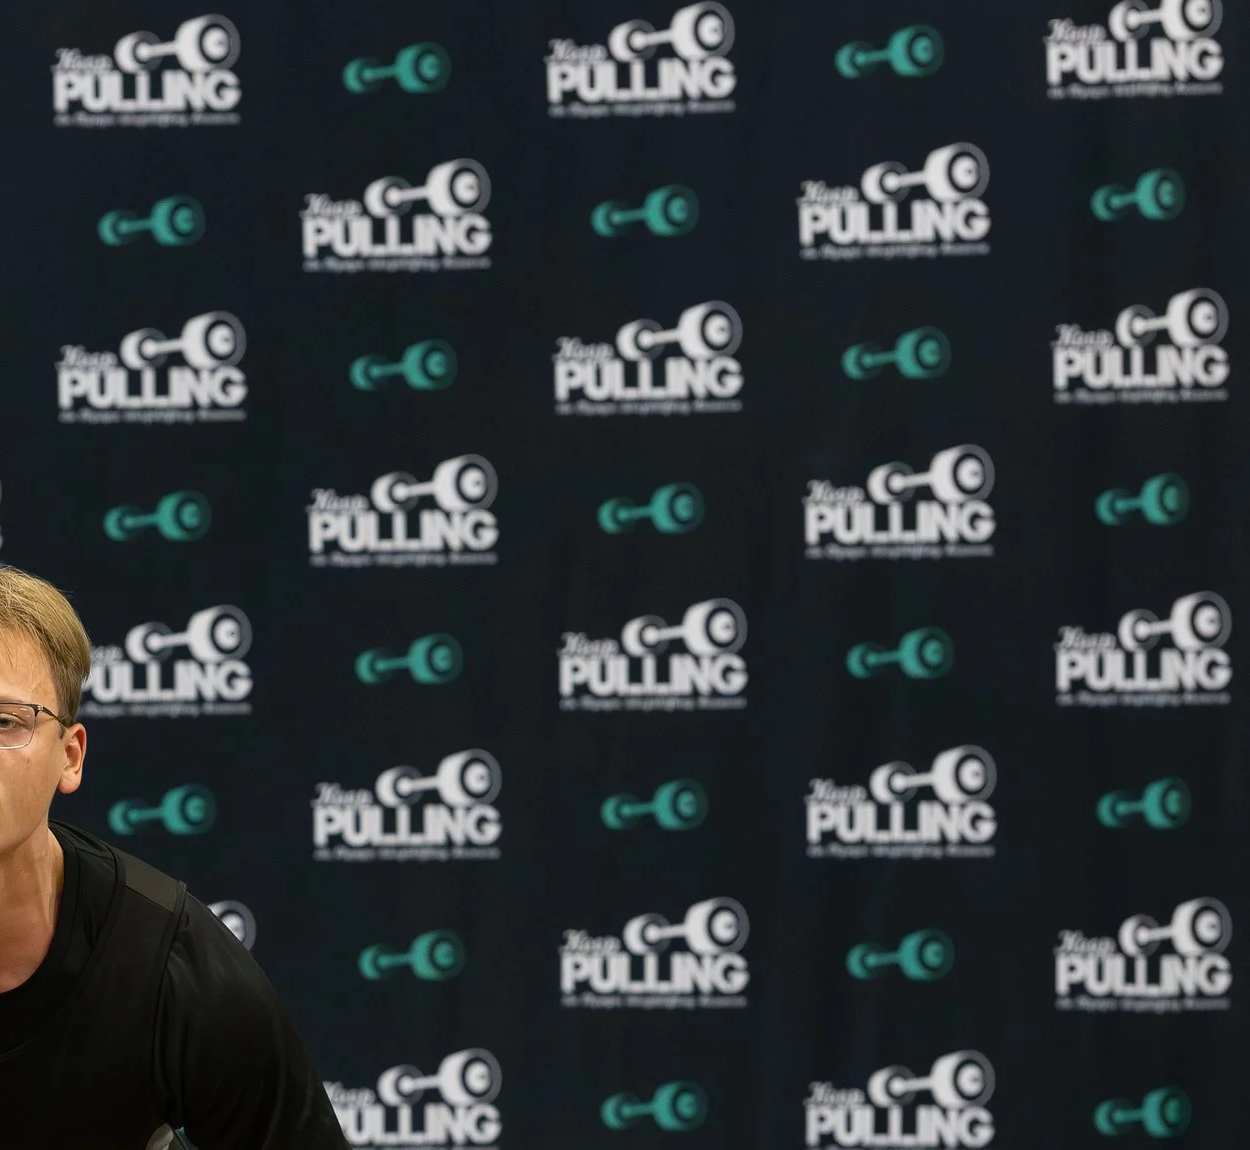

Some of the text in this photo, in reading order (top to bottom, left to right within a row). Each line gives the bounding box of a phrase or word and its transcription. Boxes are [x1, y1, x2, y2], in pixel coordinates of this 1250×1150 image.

[547, 58, 736, 101] PULLING
[1048, 38, 1222, 82] PULLING
[52, 69, 241, 112] PULLING
[302, 214, 491, 257] PULLING
[798, 199, 991, 243] PULLING
[58, 366, 247, 408] PULLING
[554, 357, 743, 400] PULLING
[1056, 344, 1226, 388] PULLING
[309, 510, 498, 552] PULLING
[803, 501, 996, 544] PULLING
[81, 658, 253, 702] ULLING
[559, 653, 748, 696] PULLING
[1057, 648, 1231, 691] PULLING
[313, 804, 502, 846] PULLING
[805, 800, 998, 843] PULLING
[560, 952, 749, 994] PULLING
[1057, 953, 1231, 996] PULLING
[805, 1105, 994, 1147] PULLING
